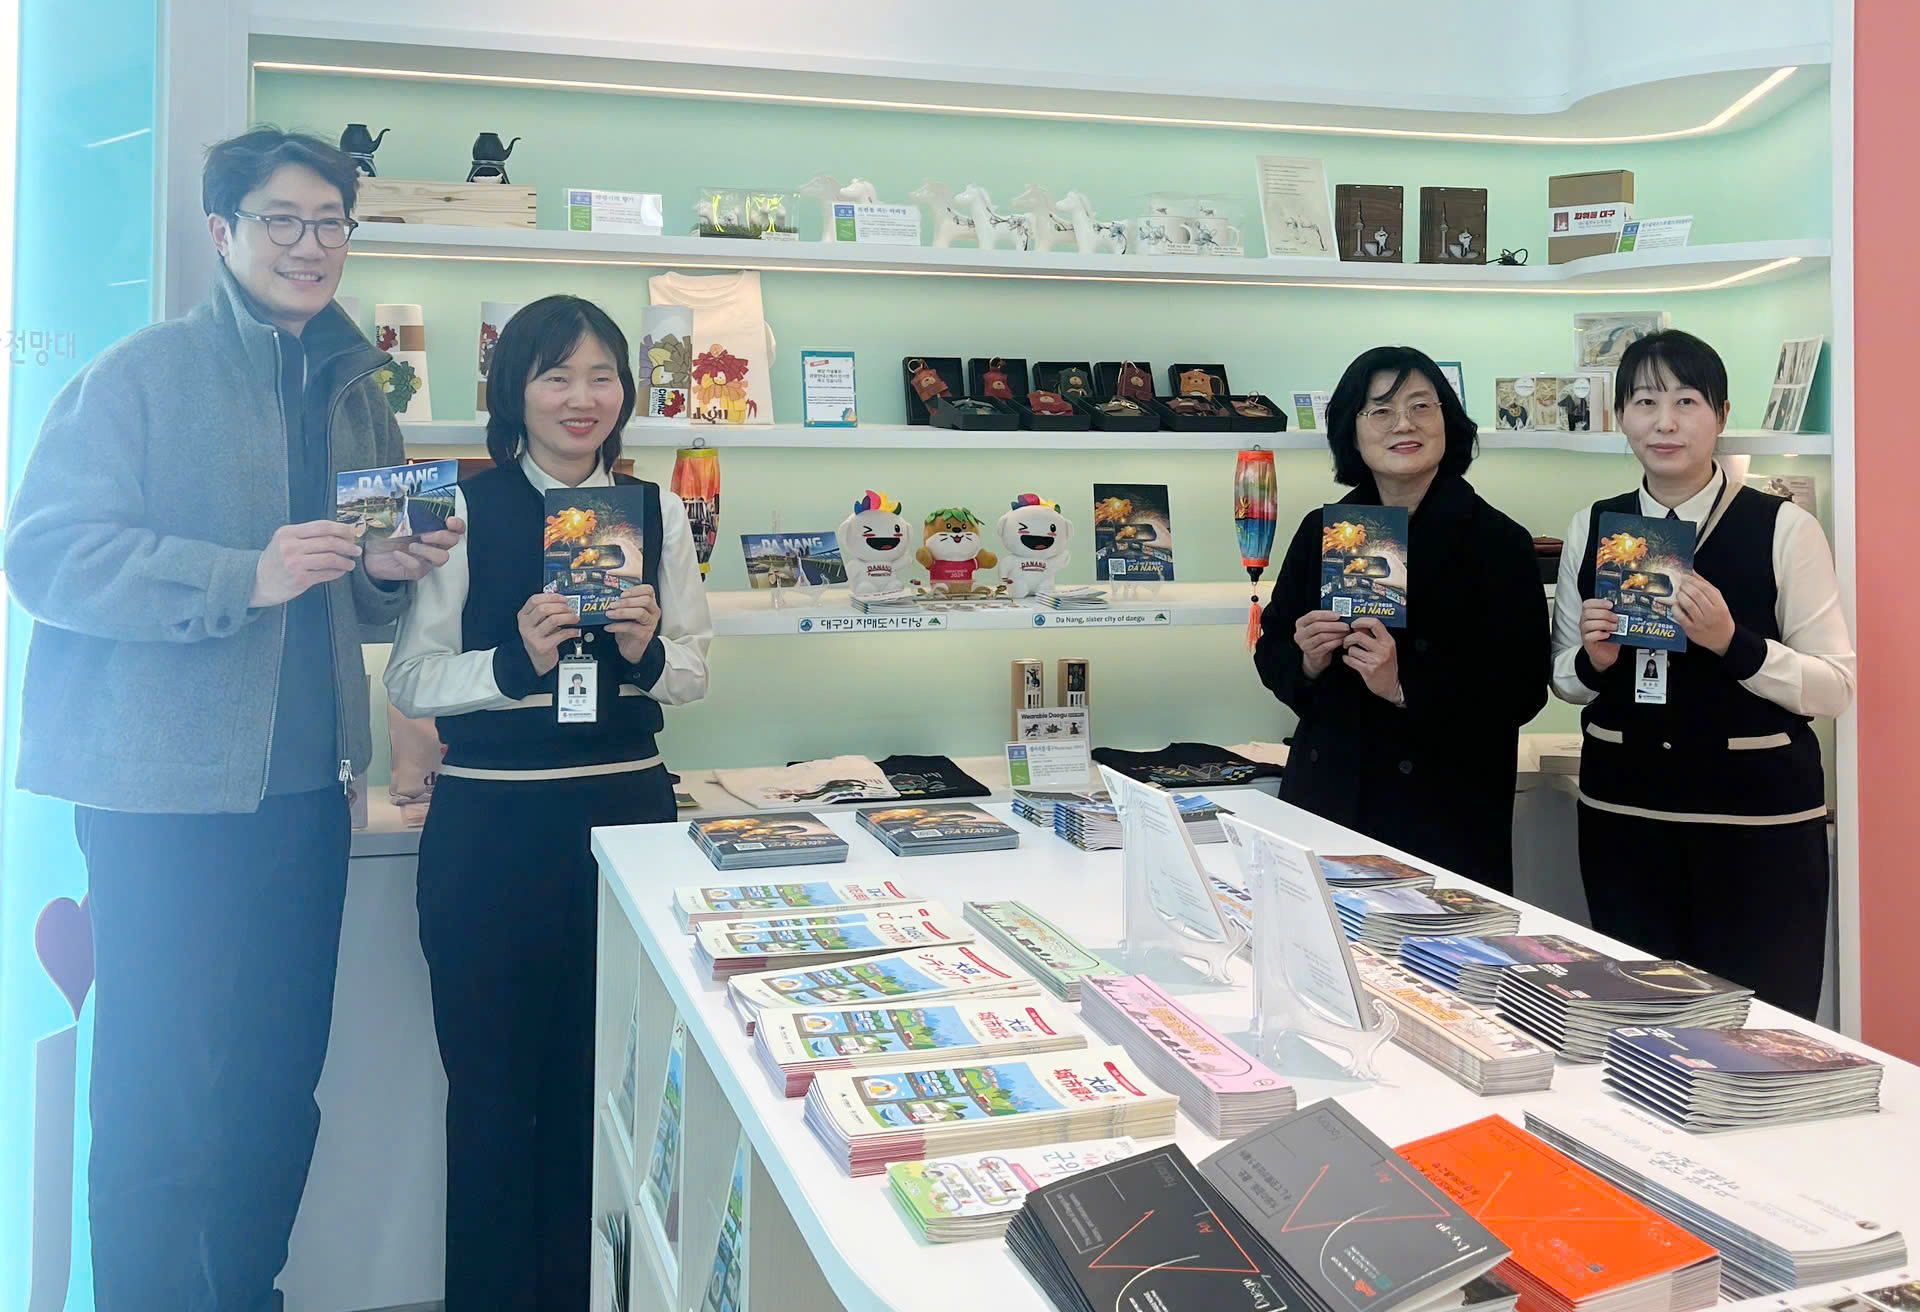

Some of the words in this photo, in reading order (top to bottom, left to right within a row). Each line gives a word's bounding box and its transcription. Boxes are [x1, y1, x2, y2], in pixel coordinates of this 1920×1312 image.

[1600, 209, 1616, 218] 대구
[0, 329, 77, 367] 전망대
[358, 475, 386, 490] DA
[391, 467, 439, 491] NANG
[760, 538, 780, 549] DA
[783, 537, 823, 550] NANG
[867, 564, 892, 573] DANANG
[1021, 561, 1047, 569] DANANG
[1140, 563, 1164, 573] NANG
[582, 602, 597, 613] DA
[1353, 605, 1366, 614] DA
[1367, 606, 1396, 616] NANG
[820, 618, 853, 629] 대구의
[856, 618, 899, 629] 자매도시
[901, 617, 923, 627] 다낭
[1066, 616, 1084, 624] Nang,
[1104, 615, 1116, 623] city
[1125, 615, 1145, 623] daegu
[1629, 624, 1645, 634] DA
[1645, 624, 1676, 638] NANG
[1021, 712, 1047, 720] Wearable
[1048, 712, 1068, 720] Daegu
[918, 954, 972, 984] シティツアー
[1242, 1277, 1270, 1310] Daegu
